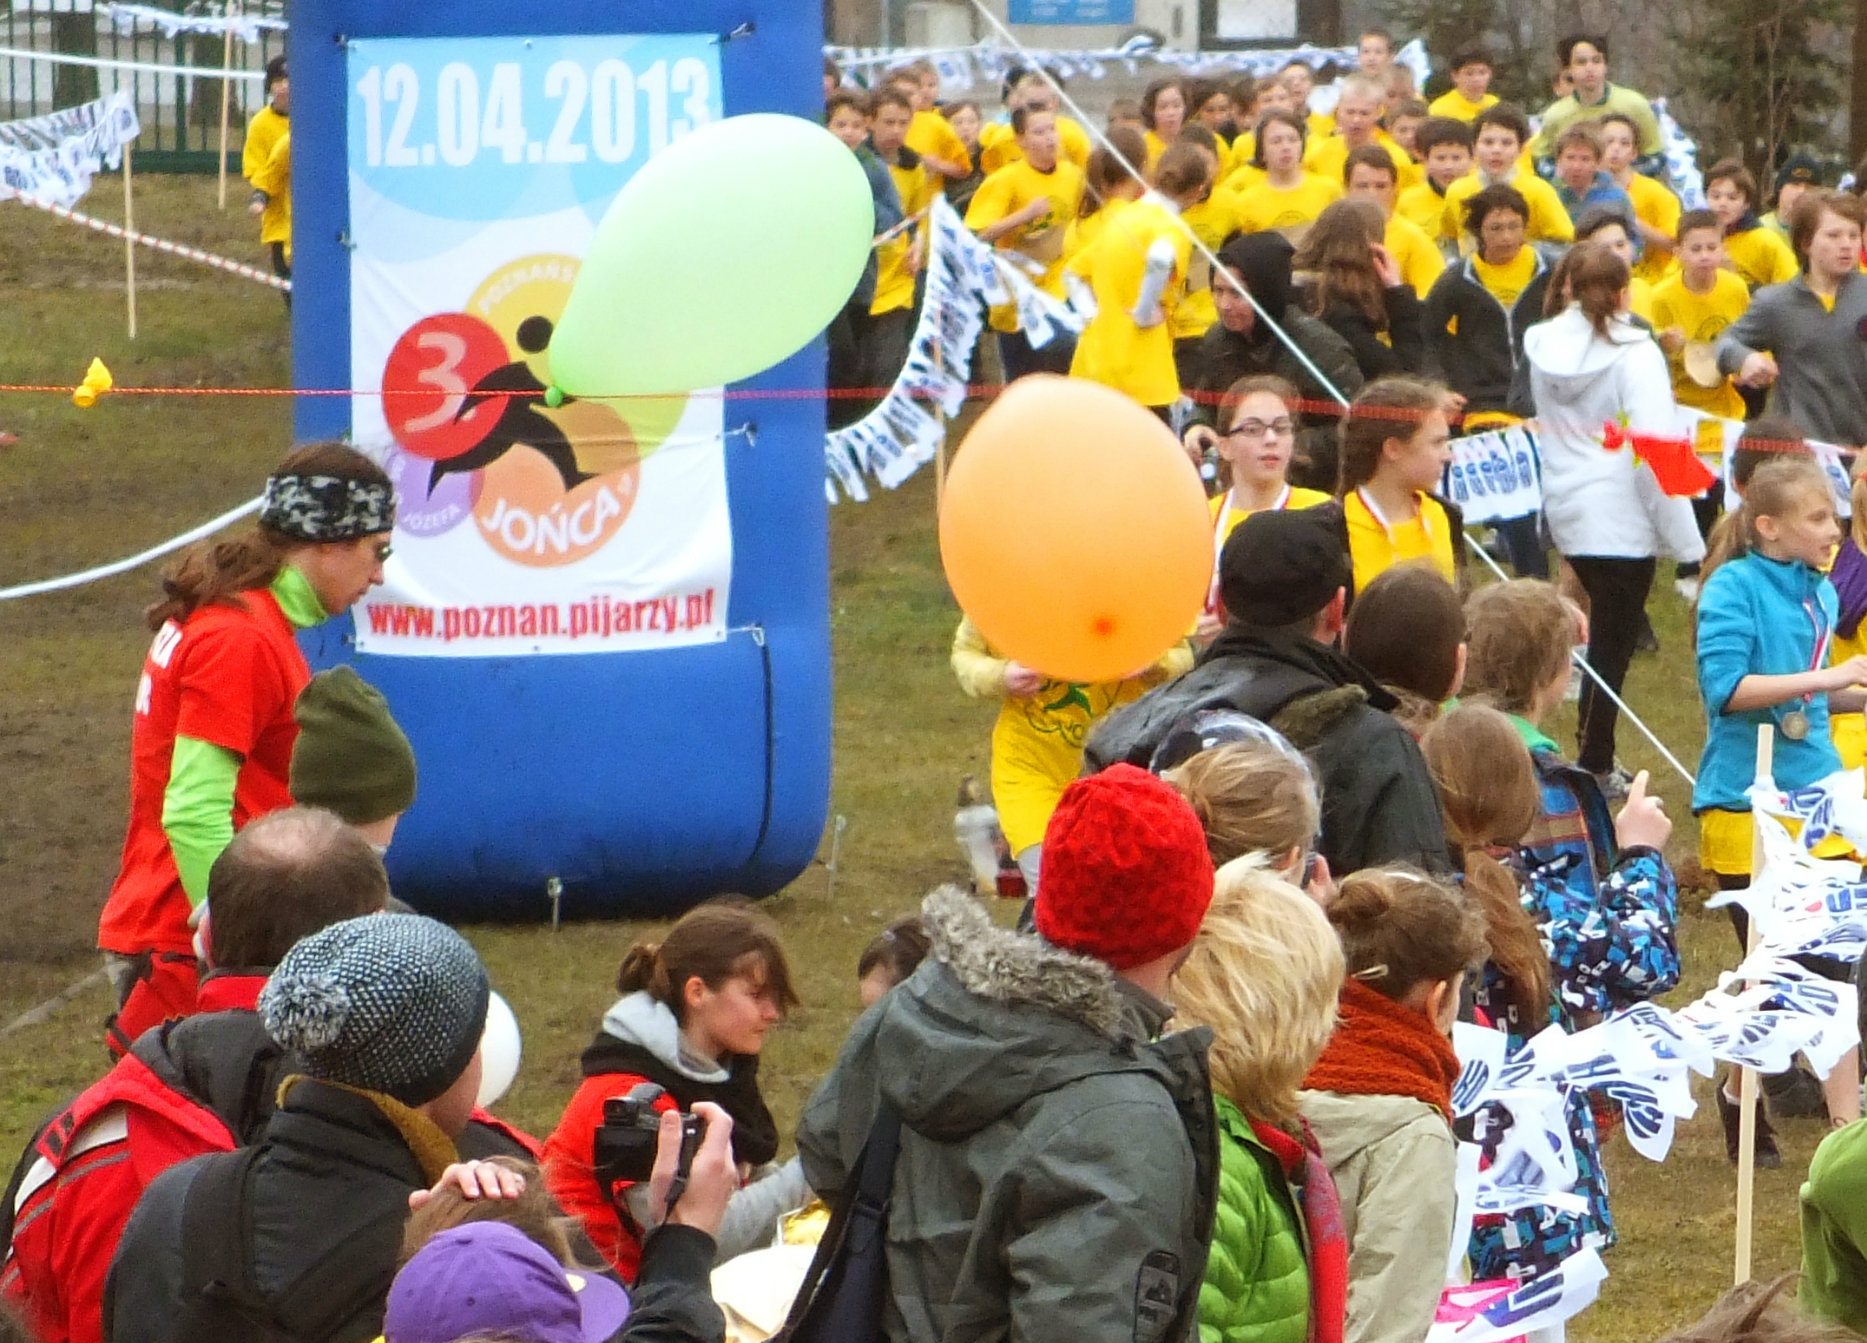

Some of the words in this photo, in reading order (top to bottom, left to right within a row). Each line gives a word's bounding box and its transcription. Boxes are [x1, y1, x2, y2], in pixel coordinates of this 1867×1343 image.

[356, 58, 711, 168] 12.04.2013
[477, 263, 577, 315] POZNAŃS
[482, 486, 621, 555] JOŃCA
[366, 588, 715, 643] www.poznan.pijarzy.pl
